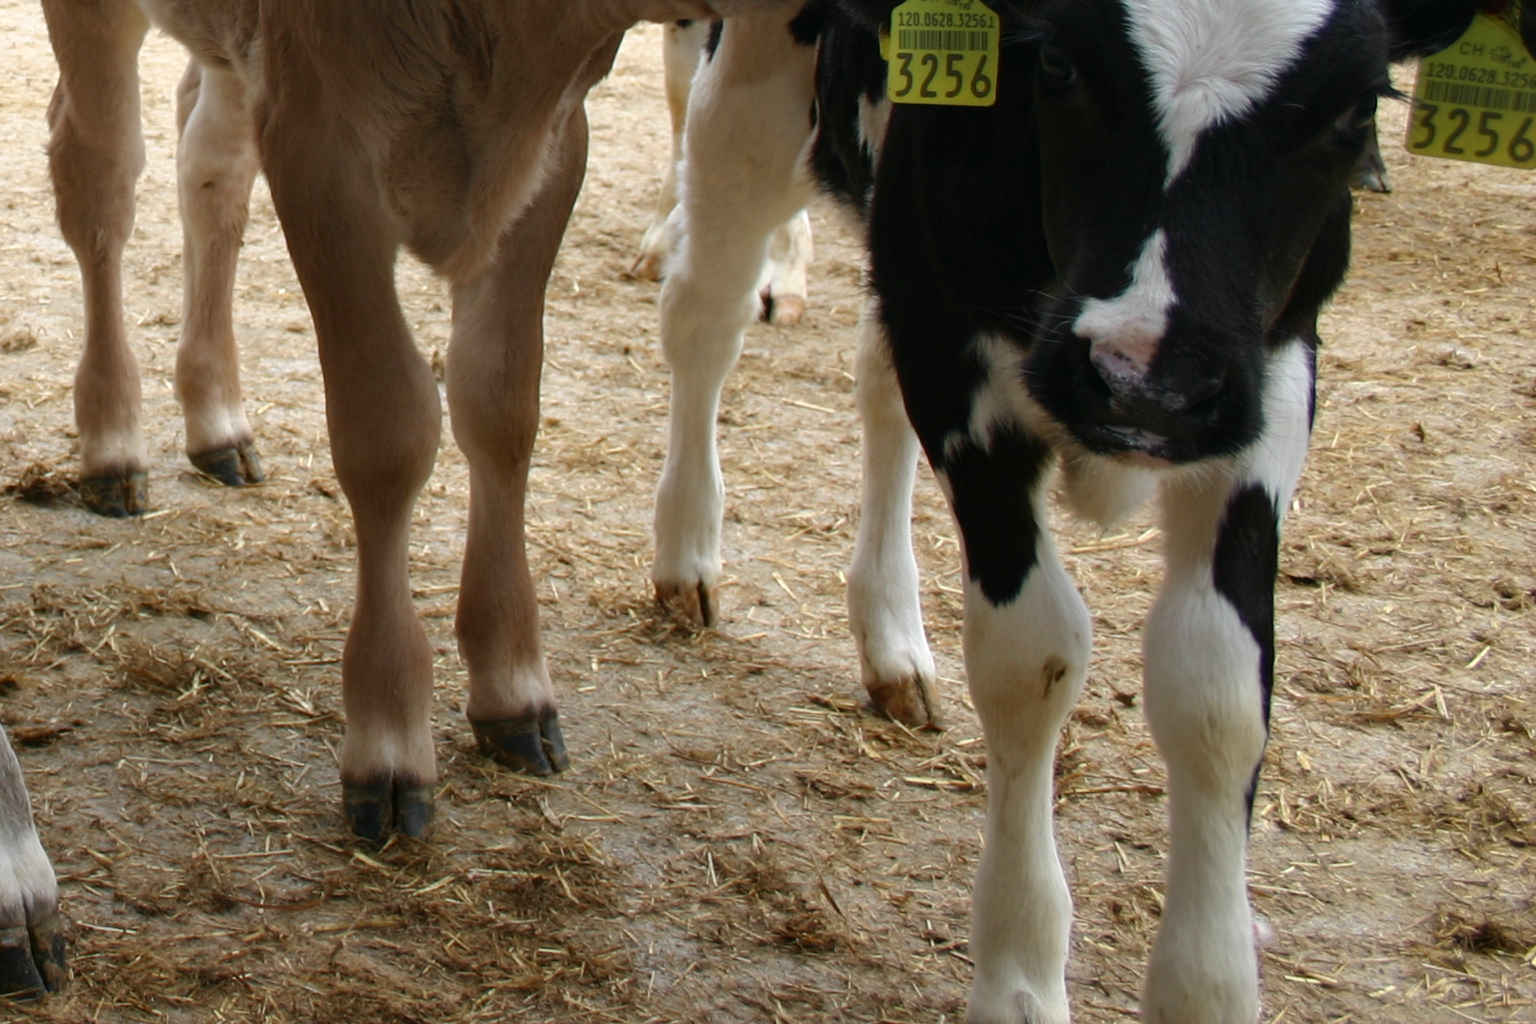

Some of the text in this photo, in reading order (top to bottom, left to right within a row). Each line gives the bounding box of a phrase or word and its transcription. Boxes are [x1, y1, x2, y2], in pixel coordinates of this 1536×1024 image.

[1459, 41, 1484, 56] CH
[894, 52, 992, 99] 3256
[1412, 103, 1535, 163] 3256
